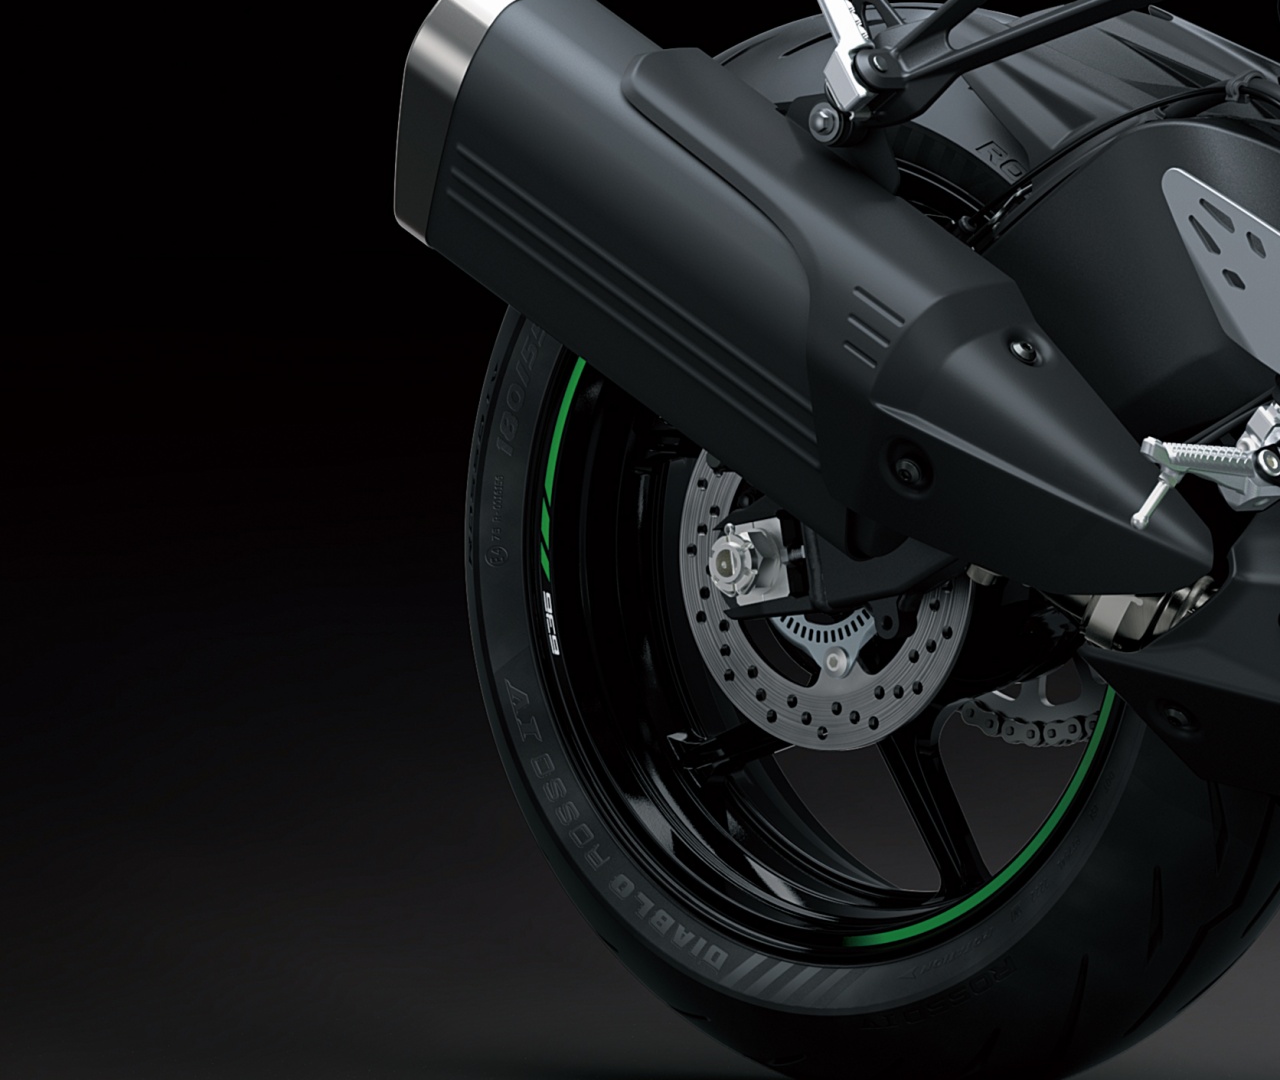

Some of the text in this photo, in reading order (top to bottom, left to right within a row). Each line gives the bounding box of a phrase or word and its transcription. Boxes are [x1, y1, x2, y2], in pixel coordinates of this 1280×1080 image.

[504, 678, 730, 973] DIABLO ROSSO IV
[902, 955, 1018, 1024] ROSSO
